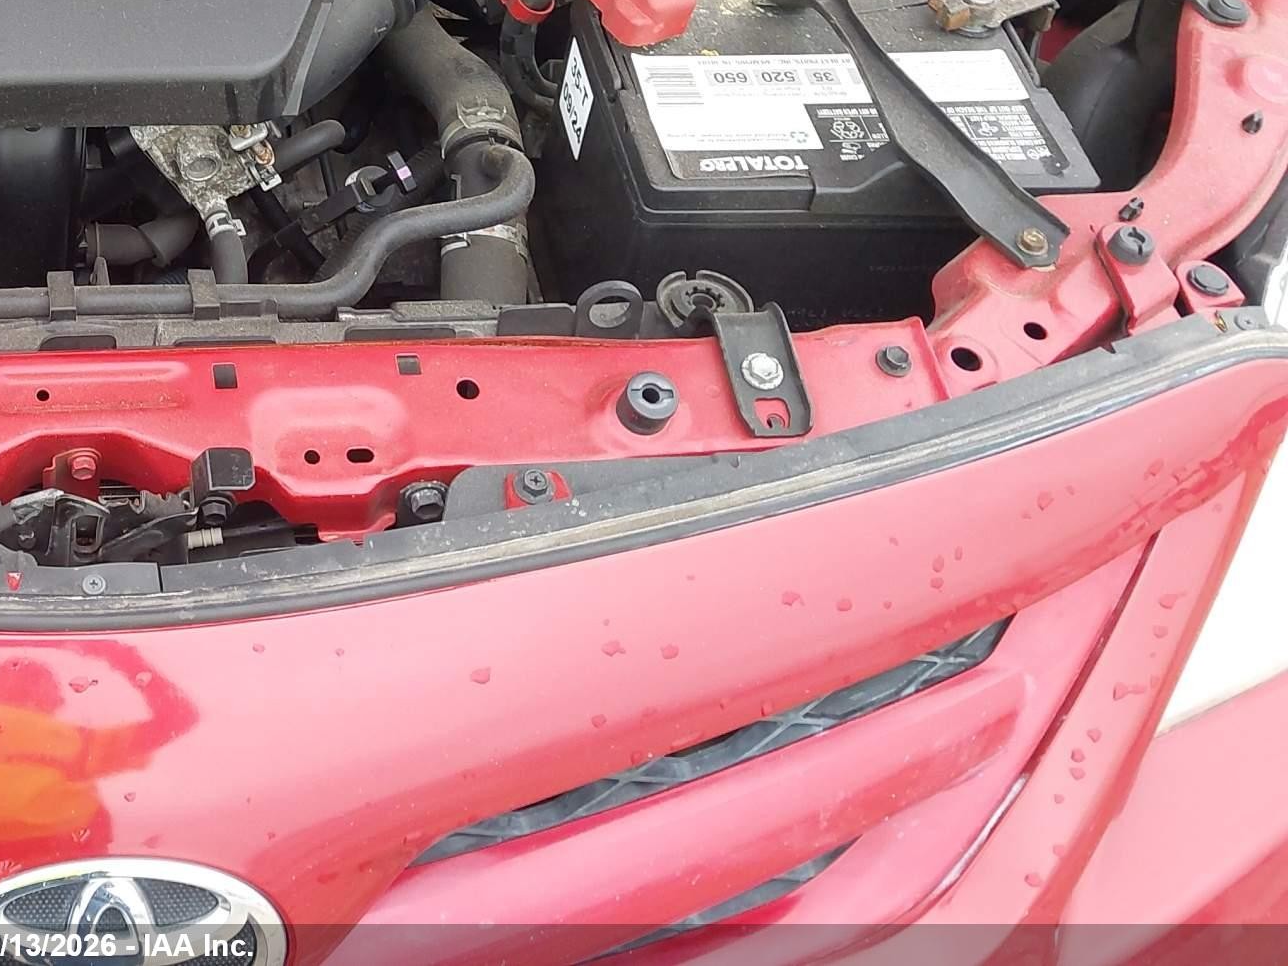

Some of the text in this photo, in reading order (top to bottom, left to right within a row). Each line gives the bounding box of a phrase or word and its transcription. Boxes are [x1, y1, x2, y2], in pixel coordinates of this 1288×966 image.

[571, 56, 589, 107] 35-T
[713, 71, 748, 84] 650
[761, 71, 796, 83] 520
[812, 71, 835, 83] 35
[563, 81, 582, 144] 09/24
